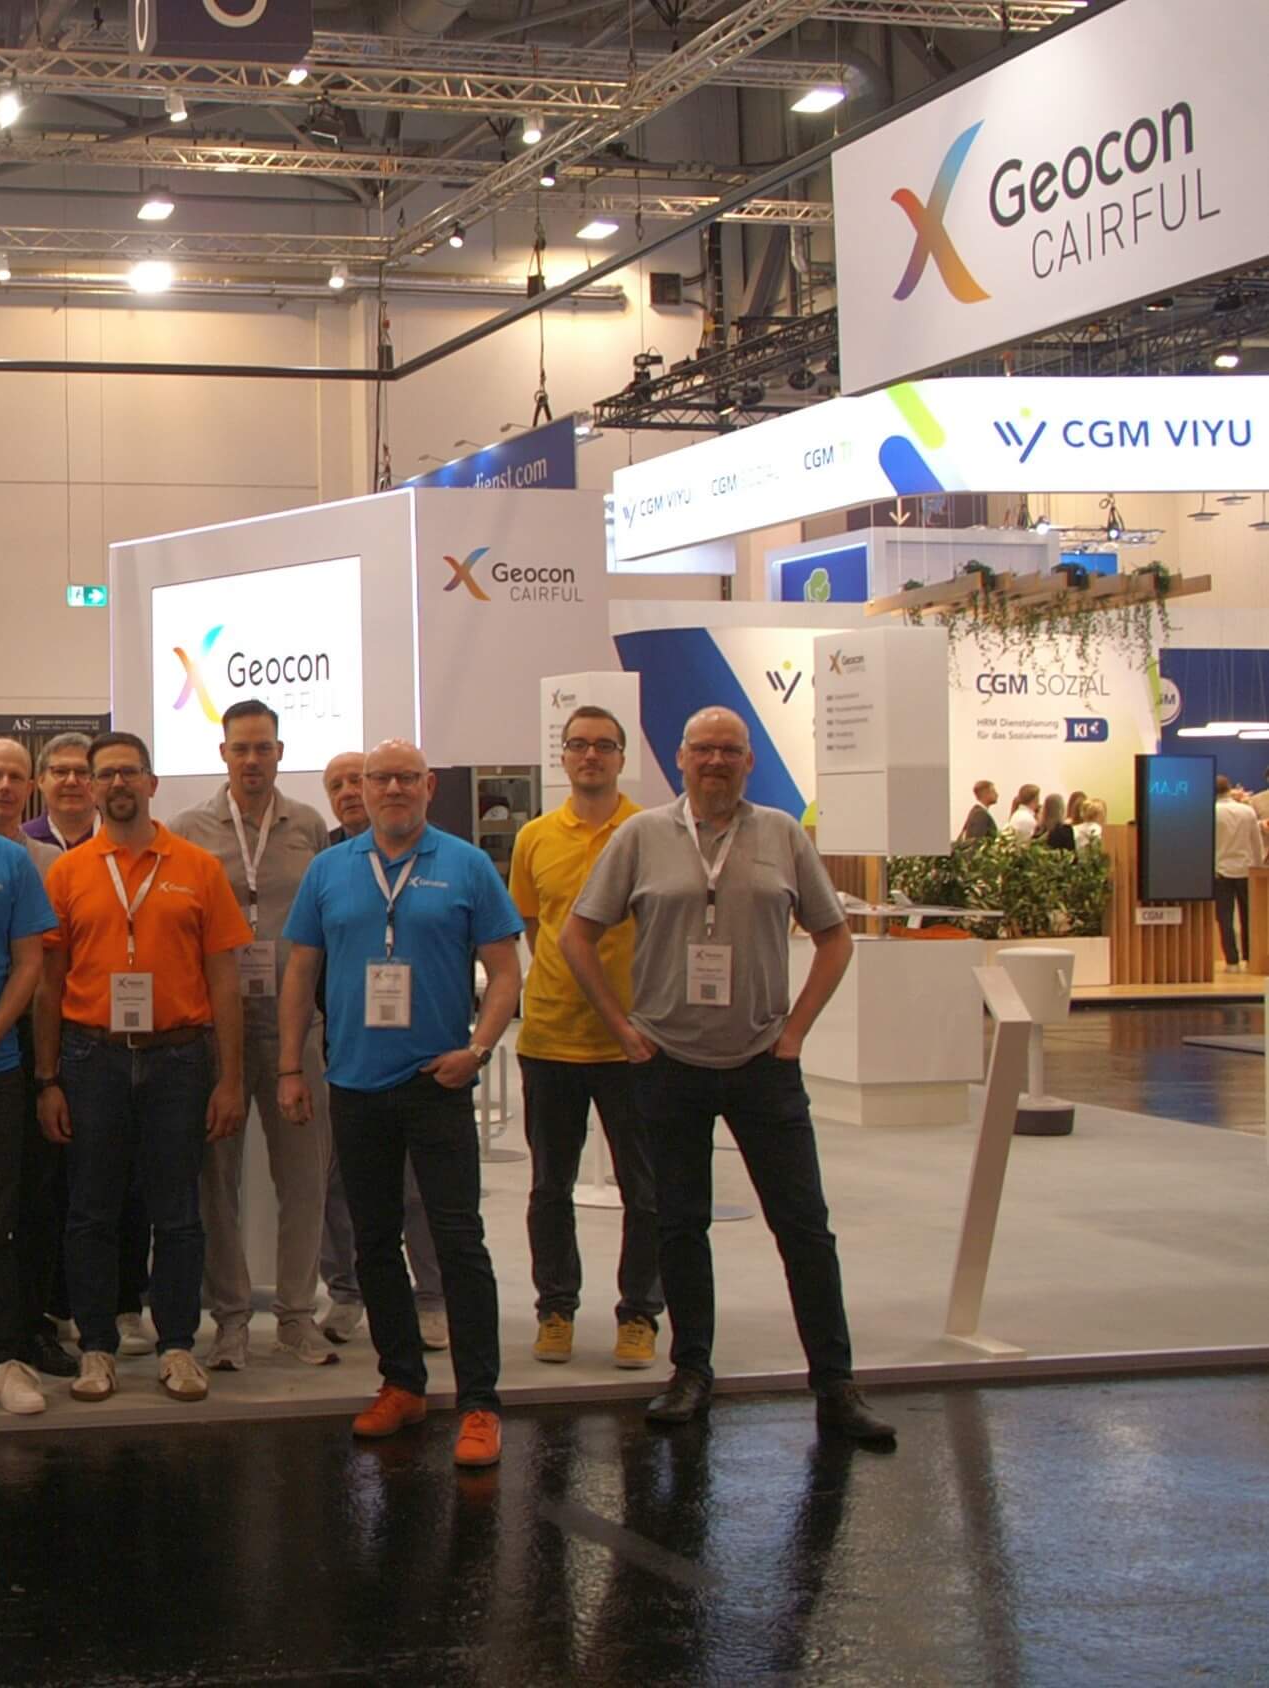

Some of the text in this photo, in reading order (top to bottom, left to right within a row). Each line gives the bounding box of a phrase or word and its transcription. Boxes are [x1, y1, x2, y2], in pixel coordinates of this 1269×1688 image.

[990, 101, 1193, 228] Geocon
[1032, 168, 1221, 279] CAIRFUL
[1062, 419, 1253, 447] CGM VIYU
[803, 446, 834, 471] CGM
[710, 473, 737, 496] CGM
[639, 496, 664, 517] CGM
[491, 562, 575, 583] Geocon
[510, 586, 584, 602] CAIRFUL
[227, 651, 330, 688] Geocon
[976, 673, 1111, 696] CGM SOZIAL
[12, 719, 31, 731] AS
[1074, 723, 1088, 738] KI
